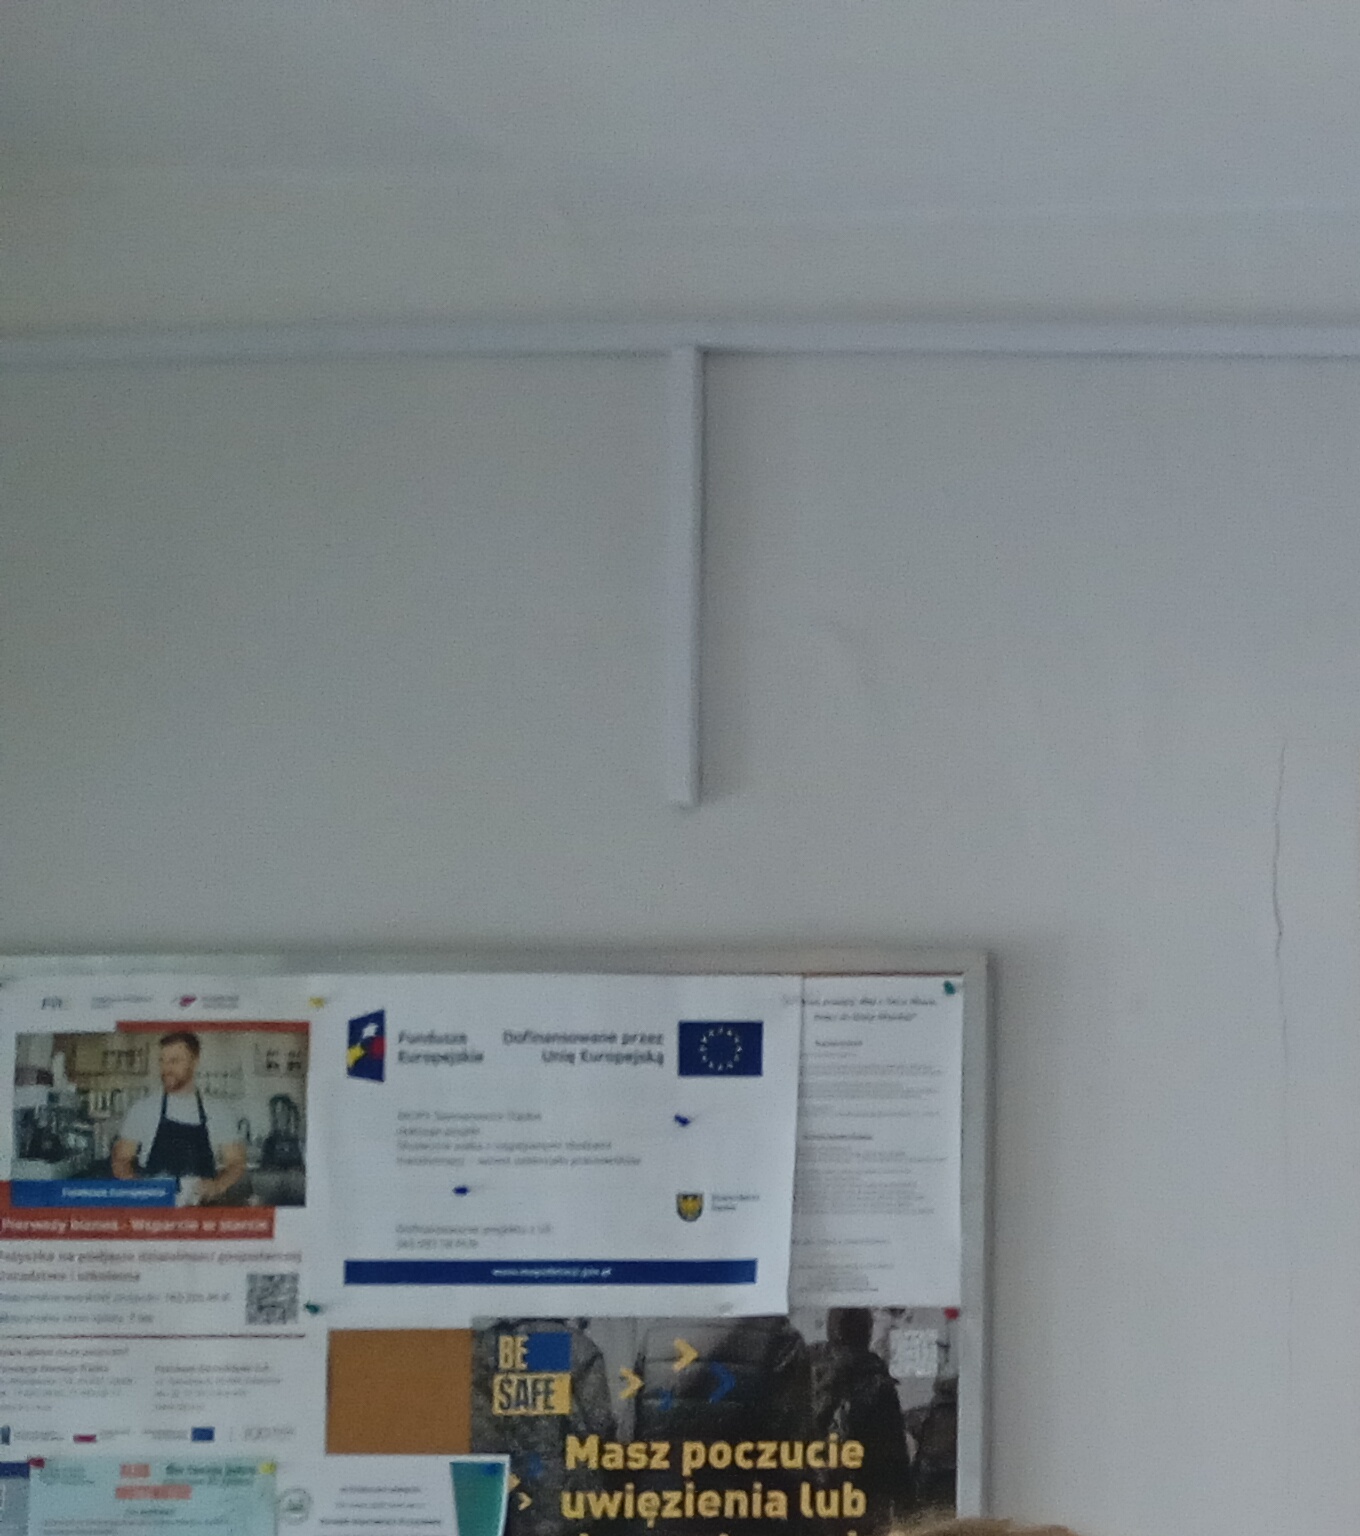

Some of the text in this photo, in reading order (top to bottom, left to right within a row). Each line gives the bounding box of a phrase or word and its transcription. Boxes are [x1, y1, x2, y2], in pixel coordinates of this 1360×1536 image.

[498, 1335, 528, 1370] BE
[499, 1377, 556, 1411] SAFE
[565, 1434, 865, 1476] Masz poczucie
[560, 1482, 867, 1527] uwięzienia lub
